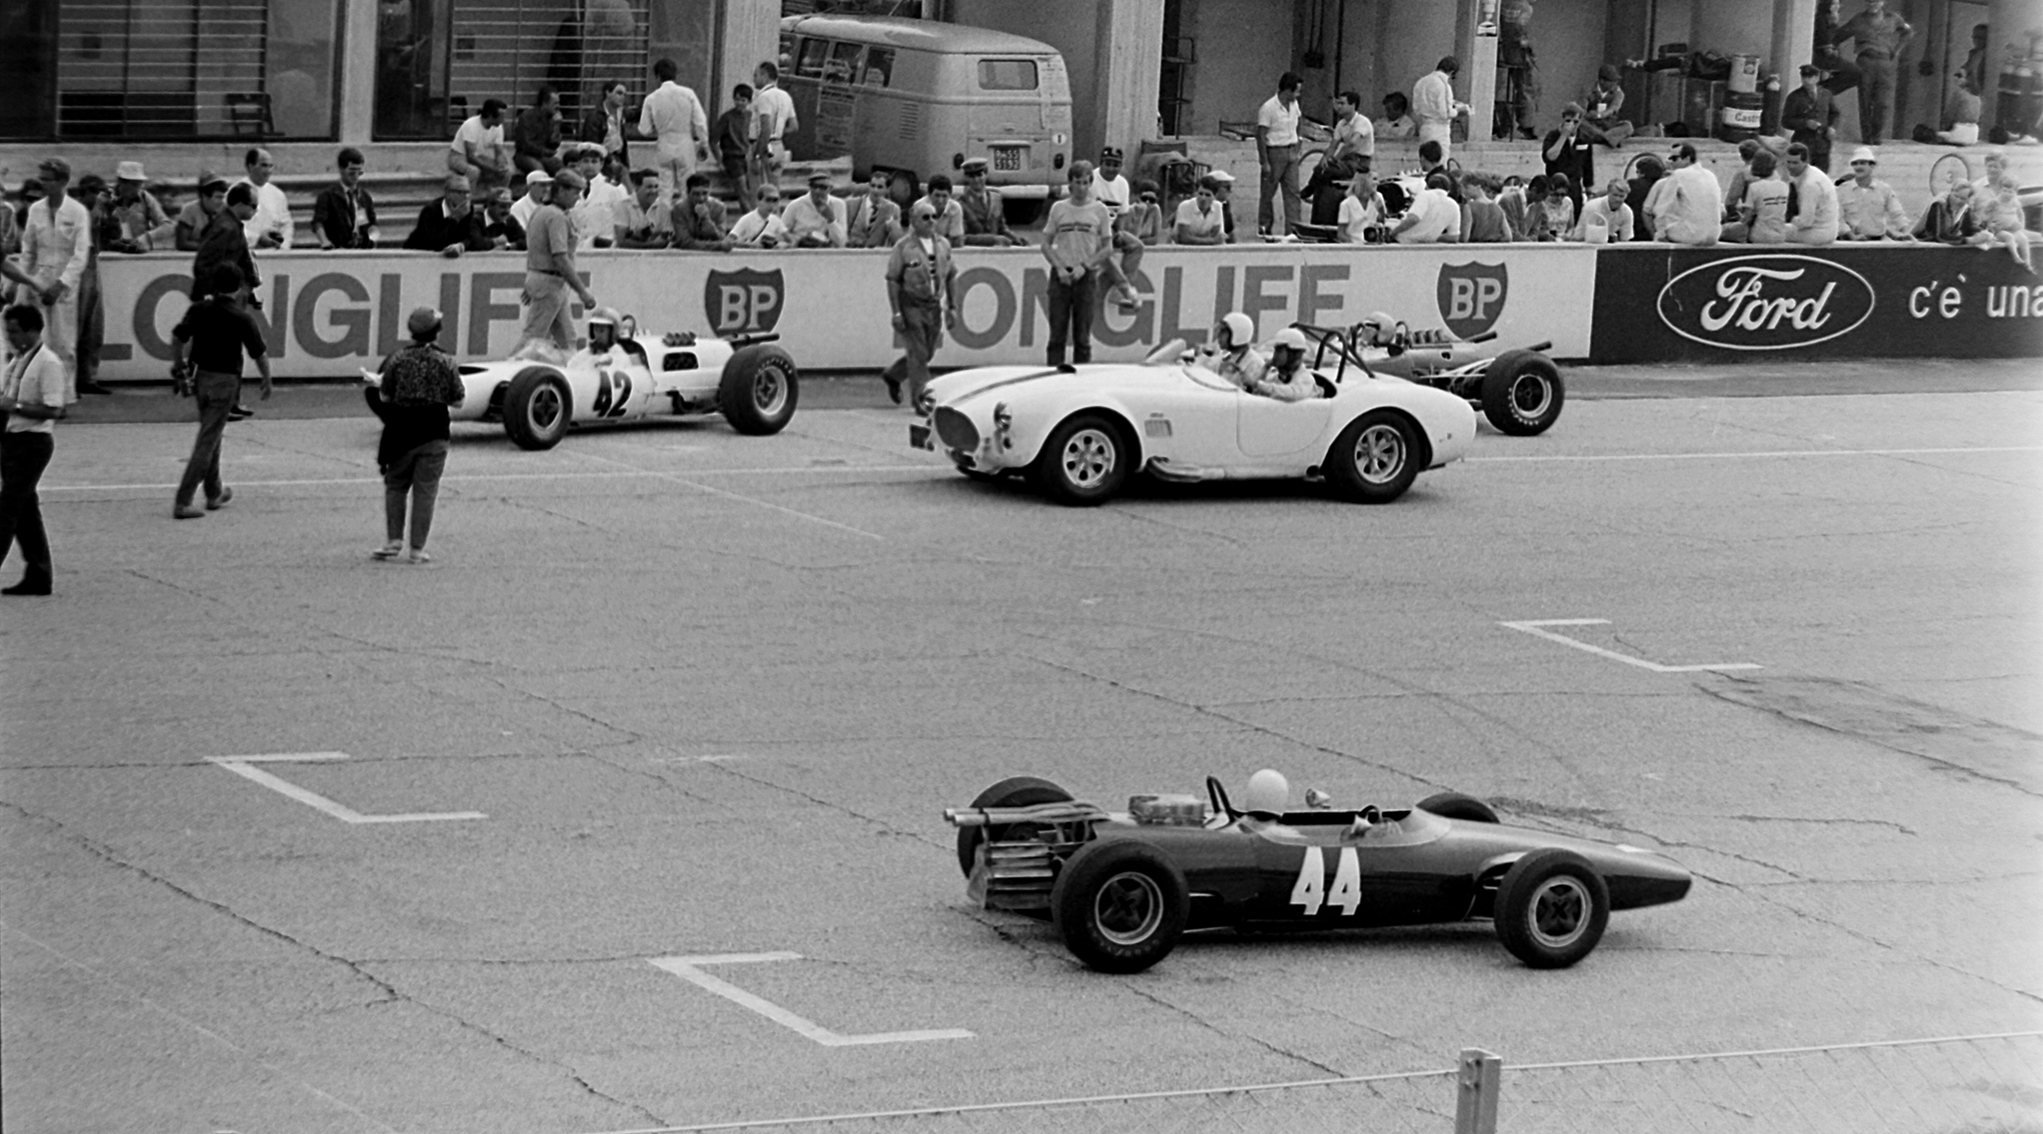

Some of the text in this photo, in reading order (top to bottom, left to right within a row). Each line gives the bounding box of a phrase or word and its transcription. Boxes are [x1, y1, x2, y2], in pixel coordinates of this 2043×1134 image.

[717, 284, 778, 330] BP
[892, 264, 1351, 350] ONGLIFE
[1446, 277, 1501, 321] BP
[1700, 266, 1838, 331] Ford
[1986, 285, 2043, 318] una
[592, 370, 633, 418] 42
[1289, 846, 1362, 916] 44
